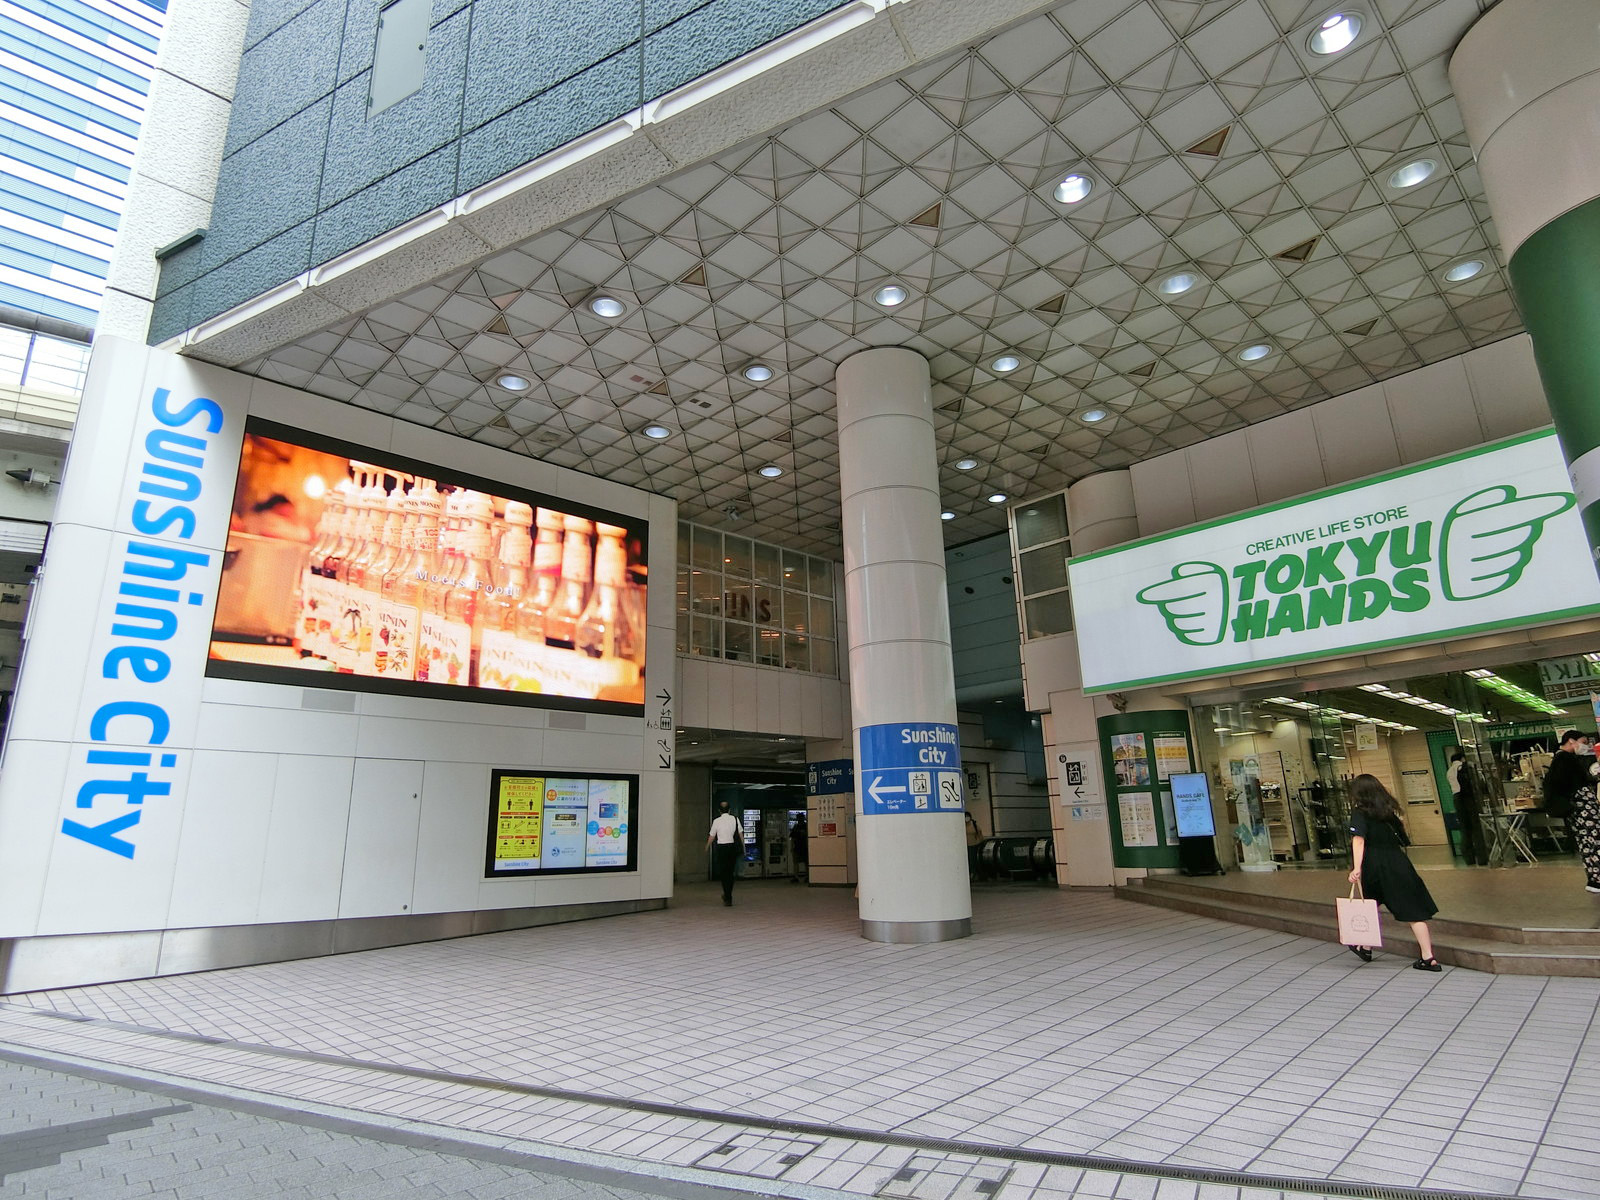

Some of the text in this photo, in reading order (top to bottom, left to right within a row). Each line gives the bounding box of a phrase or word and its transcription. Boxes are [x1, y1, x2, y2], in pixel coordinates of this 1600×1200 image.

[1246, 505, 1409, 556] CREATIVE LIFE STORE
[1232, 520, 1433, 602] TOKYU
[415, 569, 467, 588] Meets
[1231, 567, 1432, 643] HANDS
[62, 388, 224, 860] Sunshine City
[901, 726, 957, 745] Sunshine
[1487, 728, 1515, 740] KYU
[918, 746, 947, 765] City
[821, 767, 843, 777] Sunshine
